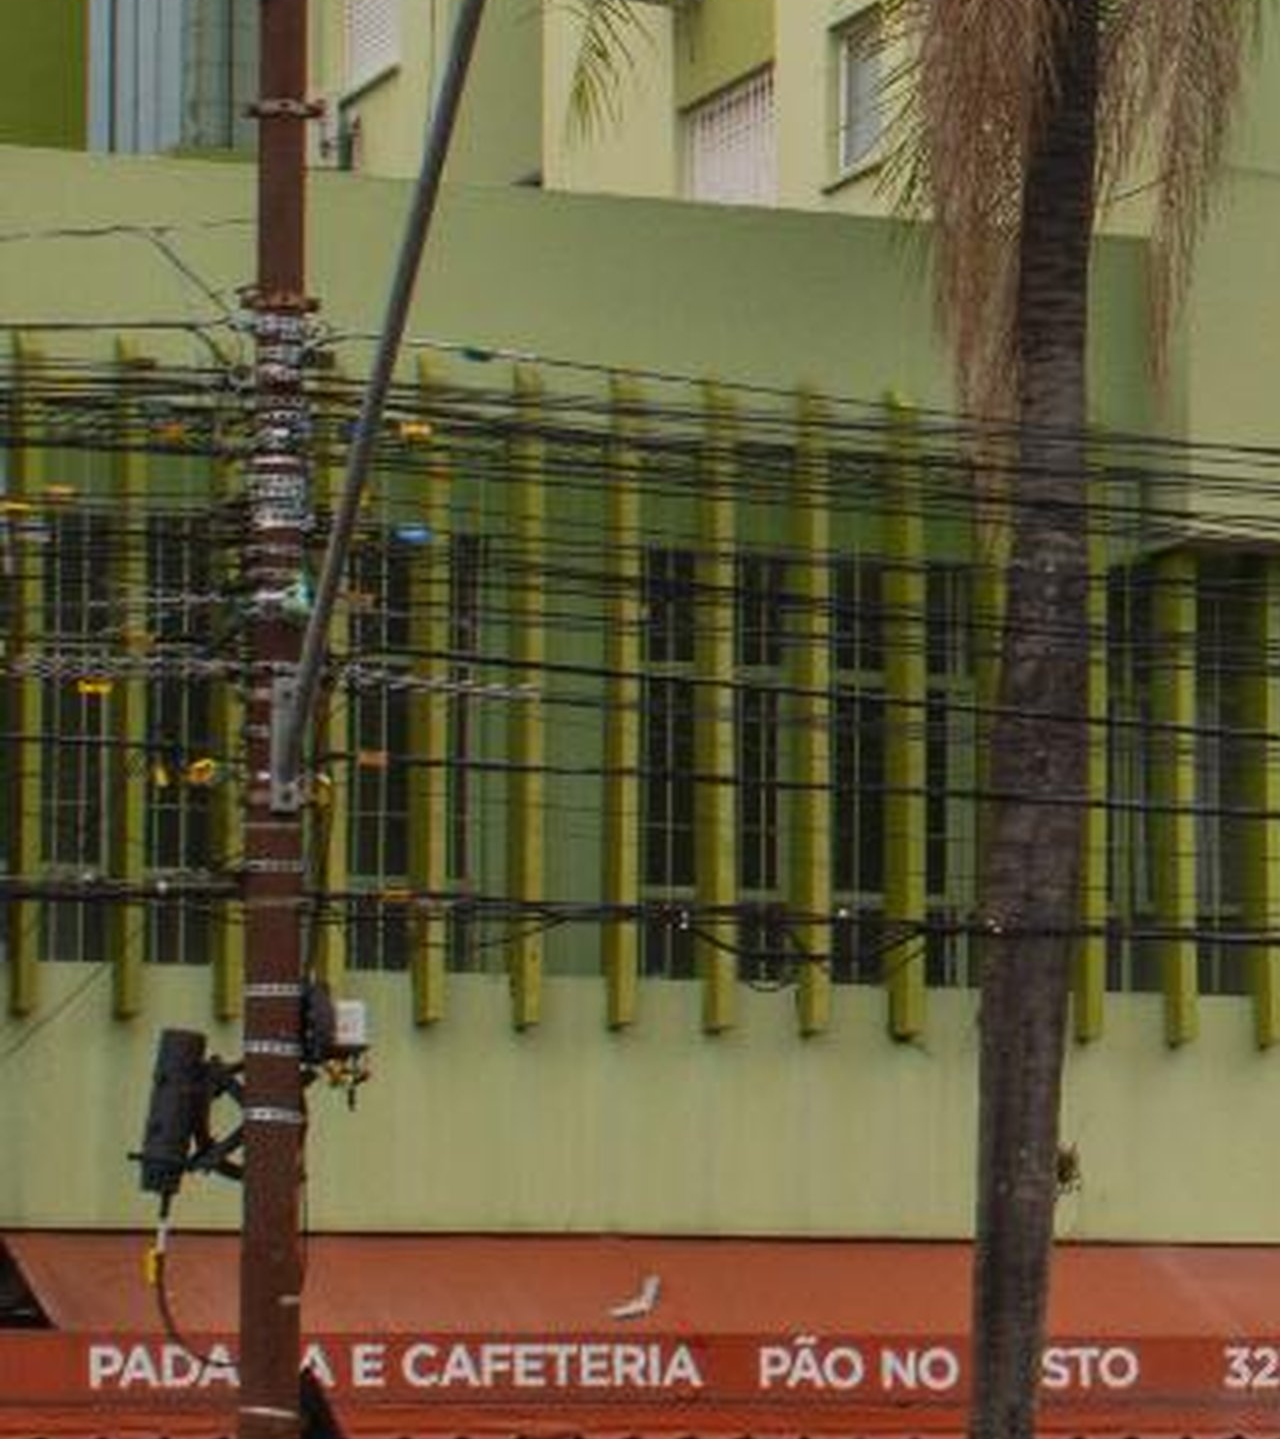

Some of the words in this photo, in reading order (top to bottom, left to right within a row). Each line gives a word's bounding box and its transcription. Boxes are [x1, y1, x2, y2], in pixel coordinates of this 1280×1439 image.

[88, 1343, 336, 1389] PADAA
[351, 1343, 386, 1388] E
[400, 1342, 704, 1388] CAFETERIA
[758, 1335, 866, 1390] PÃO
[881, 1346, 960, 1390] NO
[1038, 1345, 1141, 1389] STO
